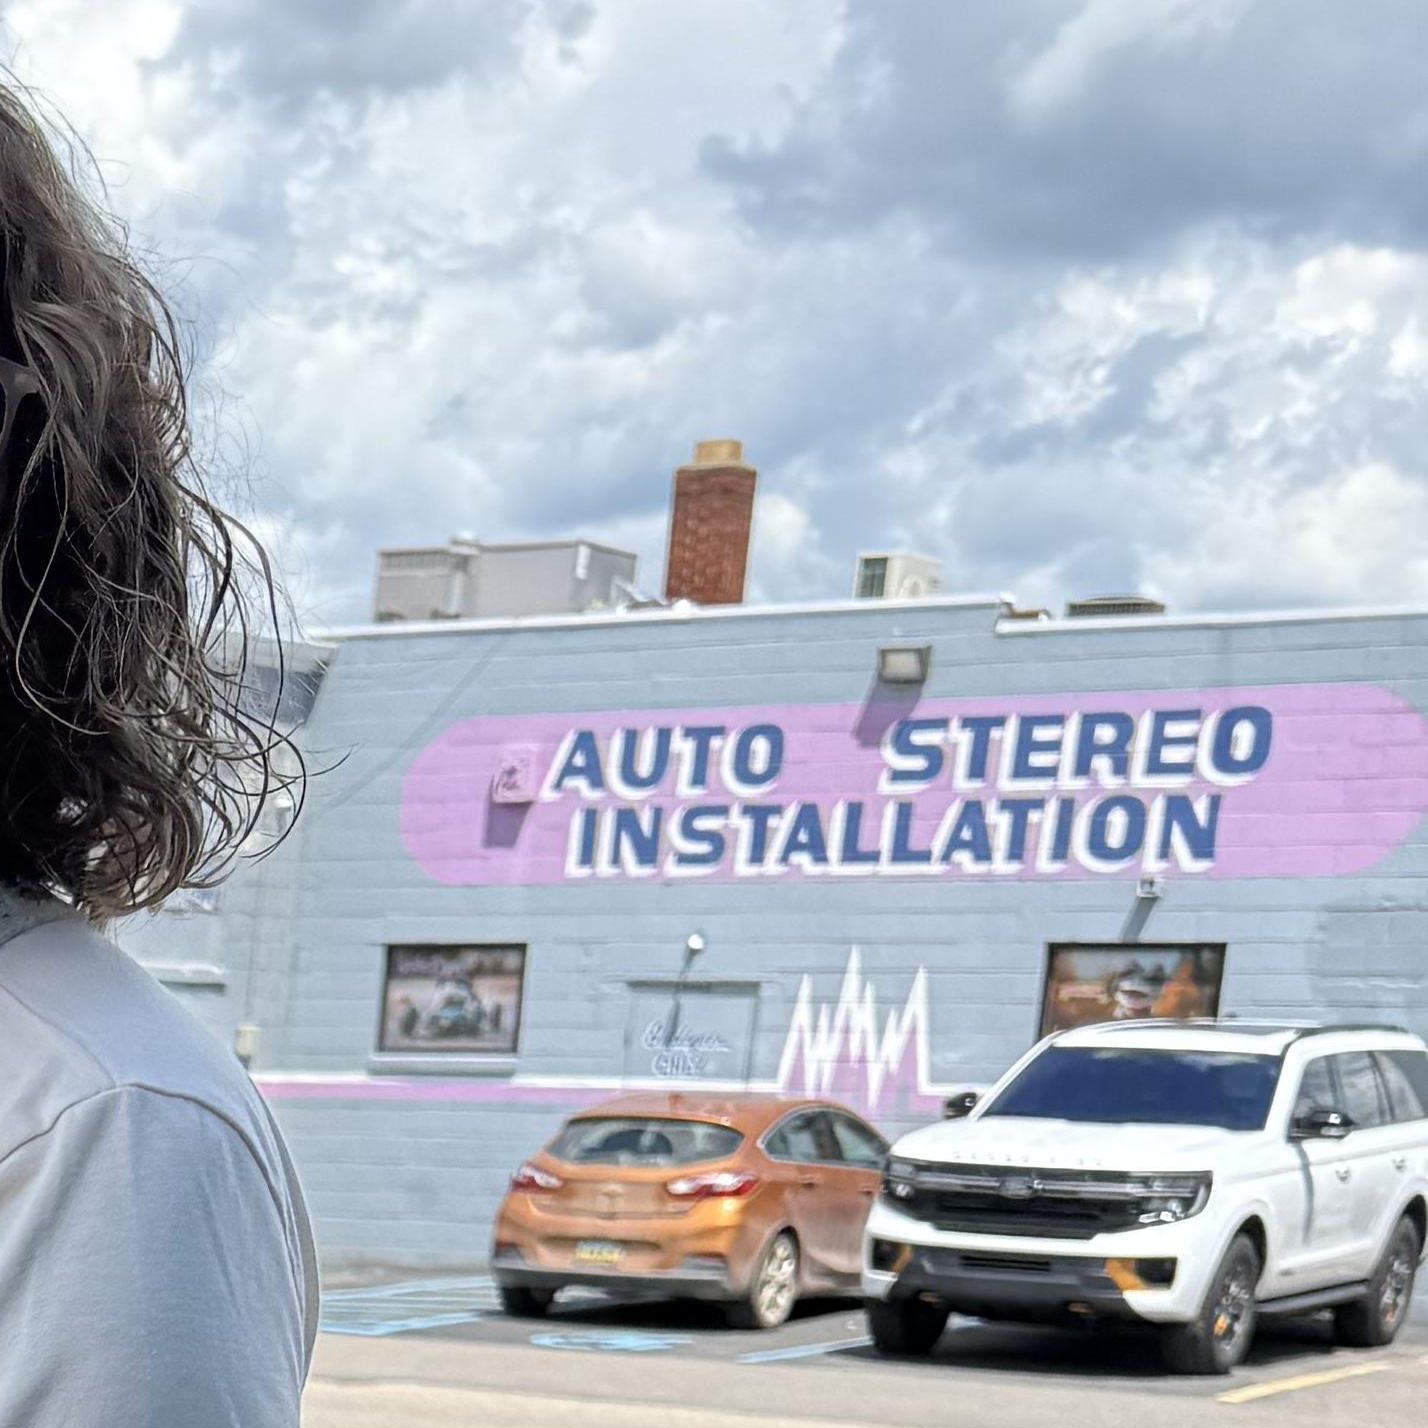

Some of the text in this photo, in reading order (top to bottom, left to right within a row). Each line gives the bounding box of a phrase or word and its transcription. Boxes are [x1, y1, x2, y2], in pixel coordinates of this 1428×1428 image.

[540, 705, 1273, 802] AUTO STEREO
[564, 794, 1222, 878] INSTALLATION
